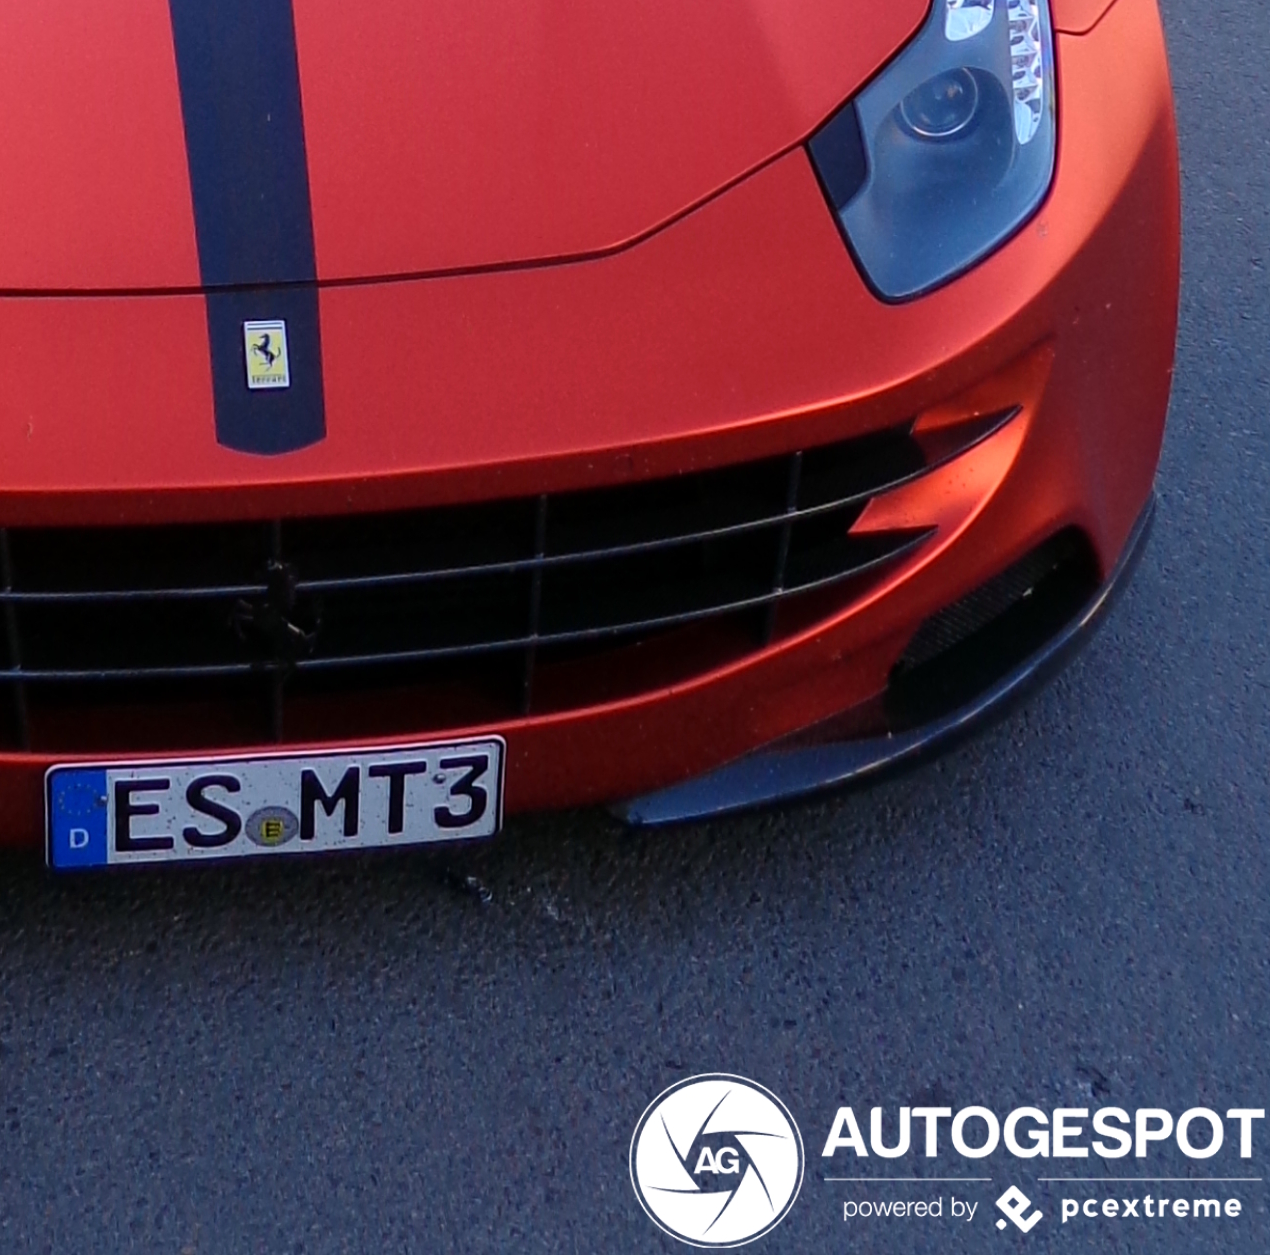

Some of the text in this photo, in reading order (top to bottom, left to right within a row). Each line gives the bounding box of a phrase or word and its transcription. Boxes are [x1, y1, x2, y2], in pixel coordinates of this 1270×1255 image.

[115, 754, 489, 852] ES MT3
[69, 828, 89, 849] D
